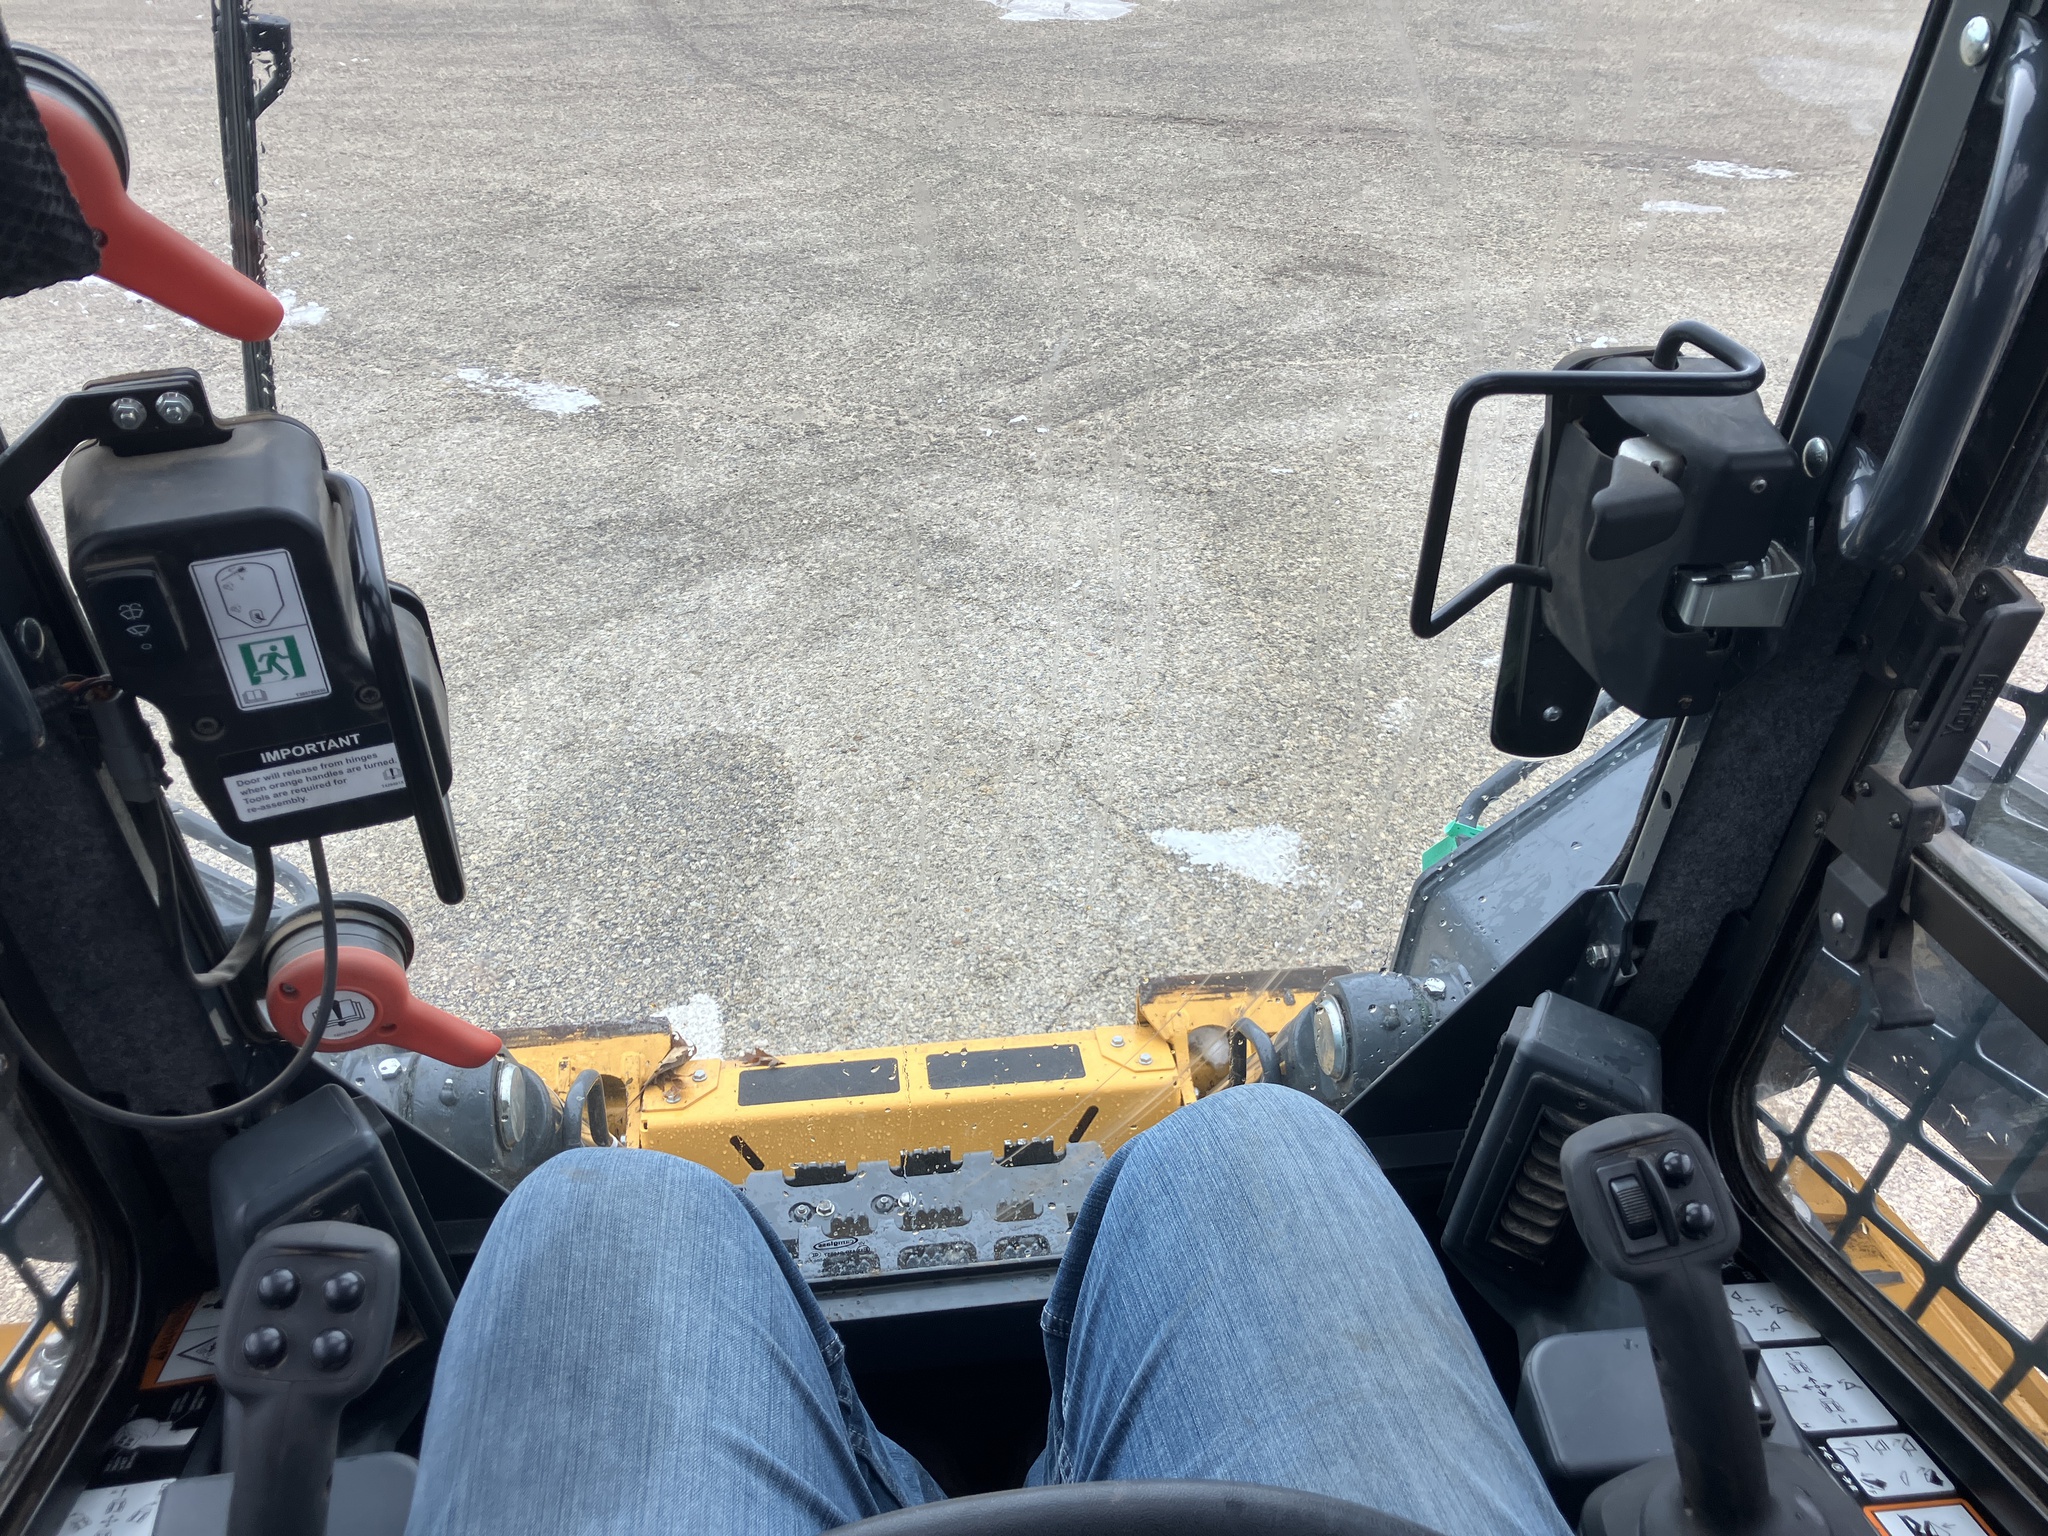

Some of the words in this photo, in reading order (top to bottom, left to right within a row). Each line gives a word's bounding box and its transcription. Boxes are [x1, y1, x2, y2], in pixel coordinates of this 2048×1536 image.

[260, 733, 361, 764] IMPORTANT
[236, 776, 261, 787] Door
[263, 772, 280, 782] will
[282, 765, 318, 778] release
[320, 761, 344, 770] from
[345, 752, 378, 766] hinges
[240, 786, 266, 797] when
[269, 778, 303, 791] orange
[305, 769, 344, 782] handles
[346, 766, 362, 774] are
[363, 757, 398, 771] turned.
[243, 794, 270, 805] Tools
[272, 790, 288, 799] are
[290, 780, 332, 796] required
[333, 777, 348, 786] for
[246, 795, 309, 814] re-assembly.
